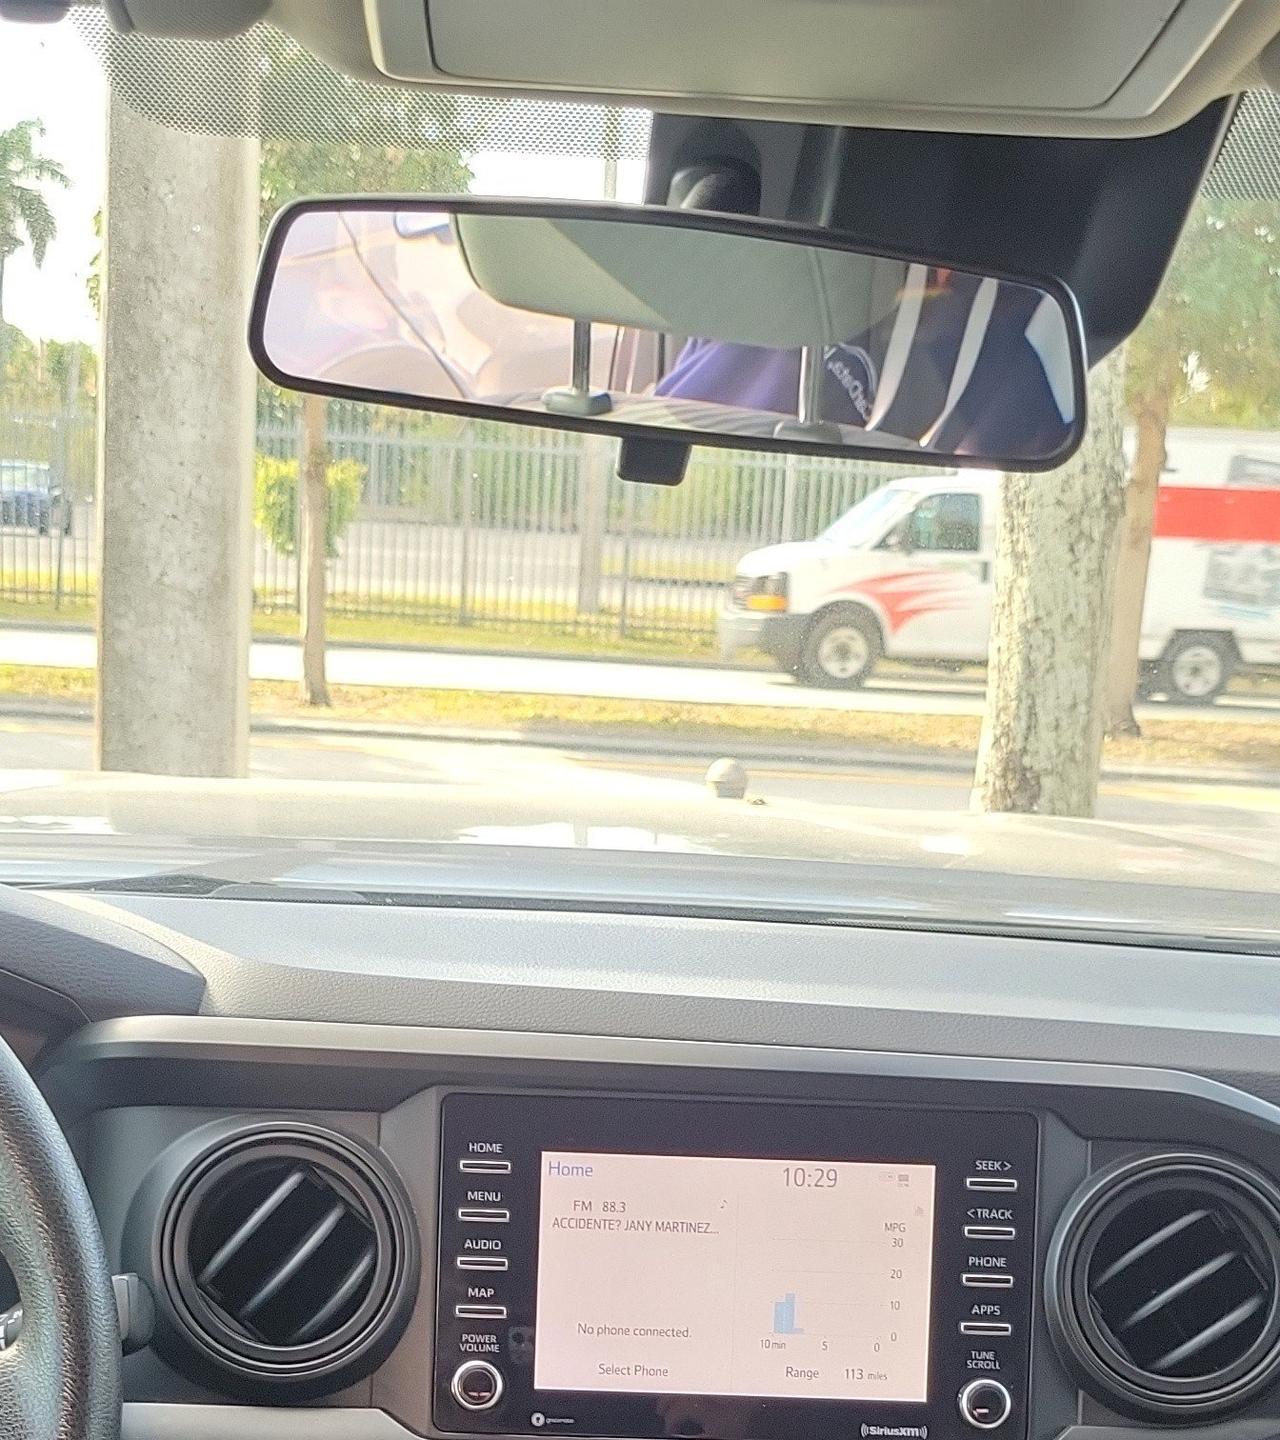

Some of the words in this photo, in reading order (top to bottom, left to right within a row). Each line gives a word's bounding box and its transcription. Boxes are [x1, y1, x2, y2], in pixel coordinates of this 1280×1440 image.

[469, 1142, 503, 1153] HOME
[548, 1161, 594, 1177] Home
[782, 1167, 838, 1188] 10:29
[467, 1191, 501, 1202] MENU
[573, 1200, 592, 1212] FM
[602, 1201, 626, 1213] 88.3
[552, 1217, 622, 1230] ACCIDENTE?
[624, 1219, 652, 1232] JANY
[884, 1222, 906, 1233] MPG
[464, 1239, 502, 1250] AUDIO
[891, 1238, 904, 1248] 30
[968, 1257, 1007, 1268] PHONE
[890, 1269, 902, 1279] 20
[468, 1287, 495, 1298] MAP
[890, 1300, 901, 1311] 10
[971, 1305, 1001, 1315] APPS
[577, 1323, 594, 1335] No
[596, 1323, 630, 1337] phone
[633, 1326, 692, 1339] connected.
[461, 1333, 497, 1343] POWER
[891, 1332, 897, 1342] 0
[460, 1343, 500, 1353] VOLUME
[760, 1339, 770, 1349] 10
[771, 1340, 786, 1350] min
[822, 1341, 828, 1351] 5
[873, 1343, 880, 1353] 0
[970, 1350, 996, 1360] TUNE
[598, 1363, 631, 1376] Select
[634, 1364, 669, 1377] Phone
[966, 1360, 1001, 1370] SCROLL
[785, 1366, 819, 1380] Range
[844, 1368, 864, 1380] 113
[868, 1371, 888, 1381] miles
